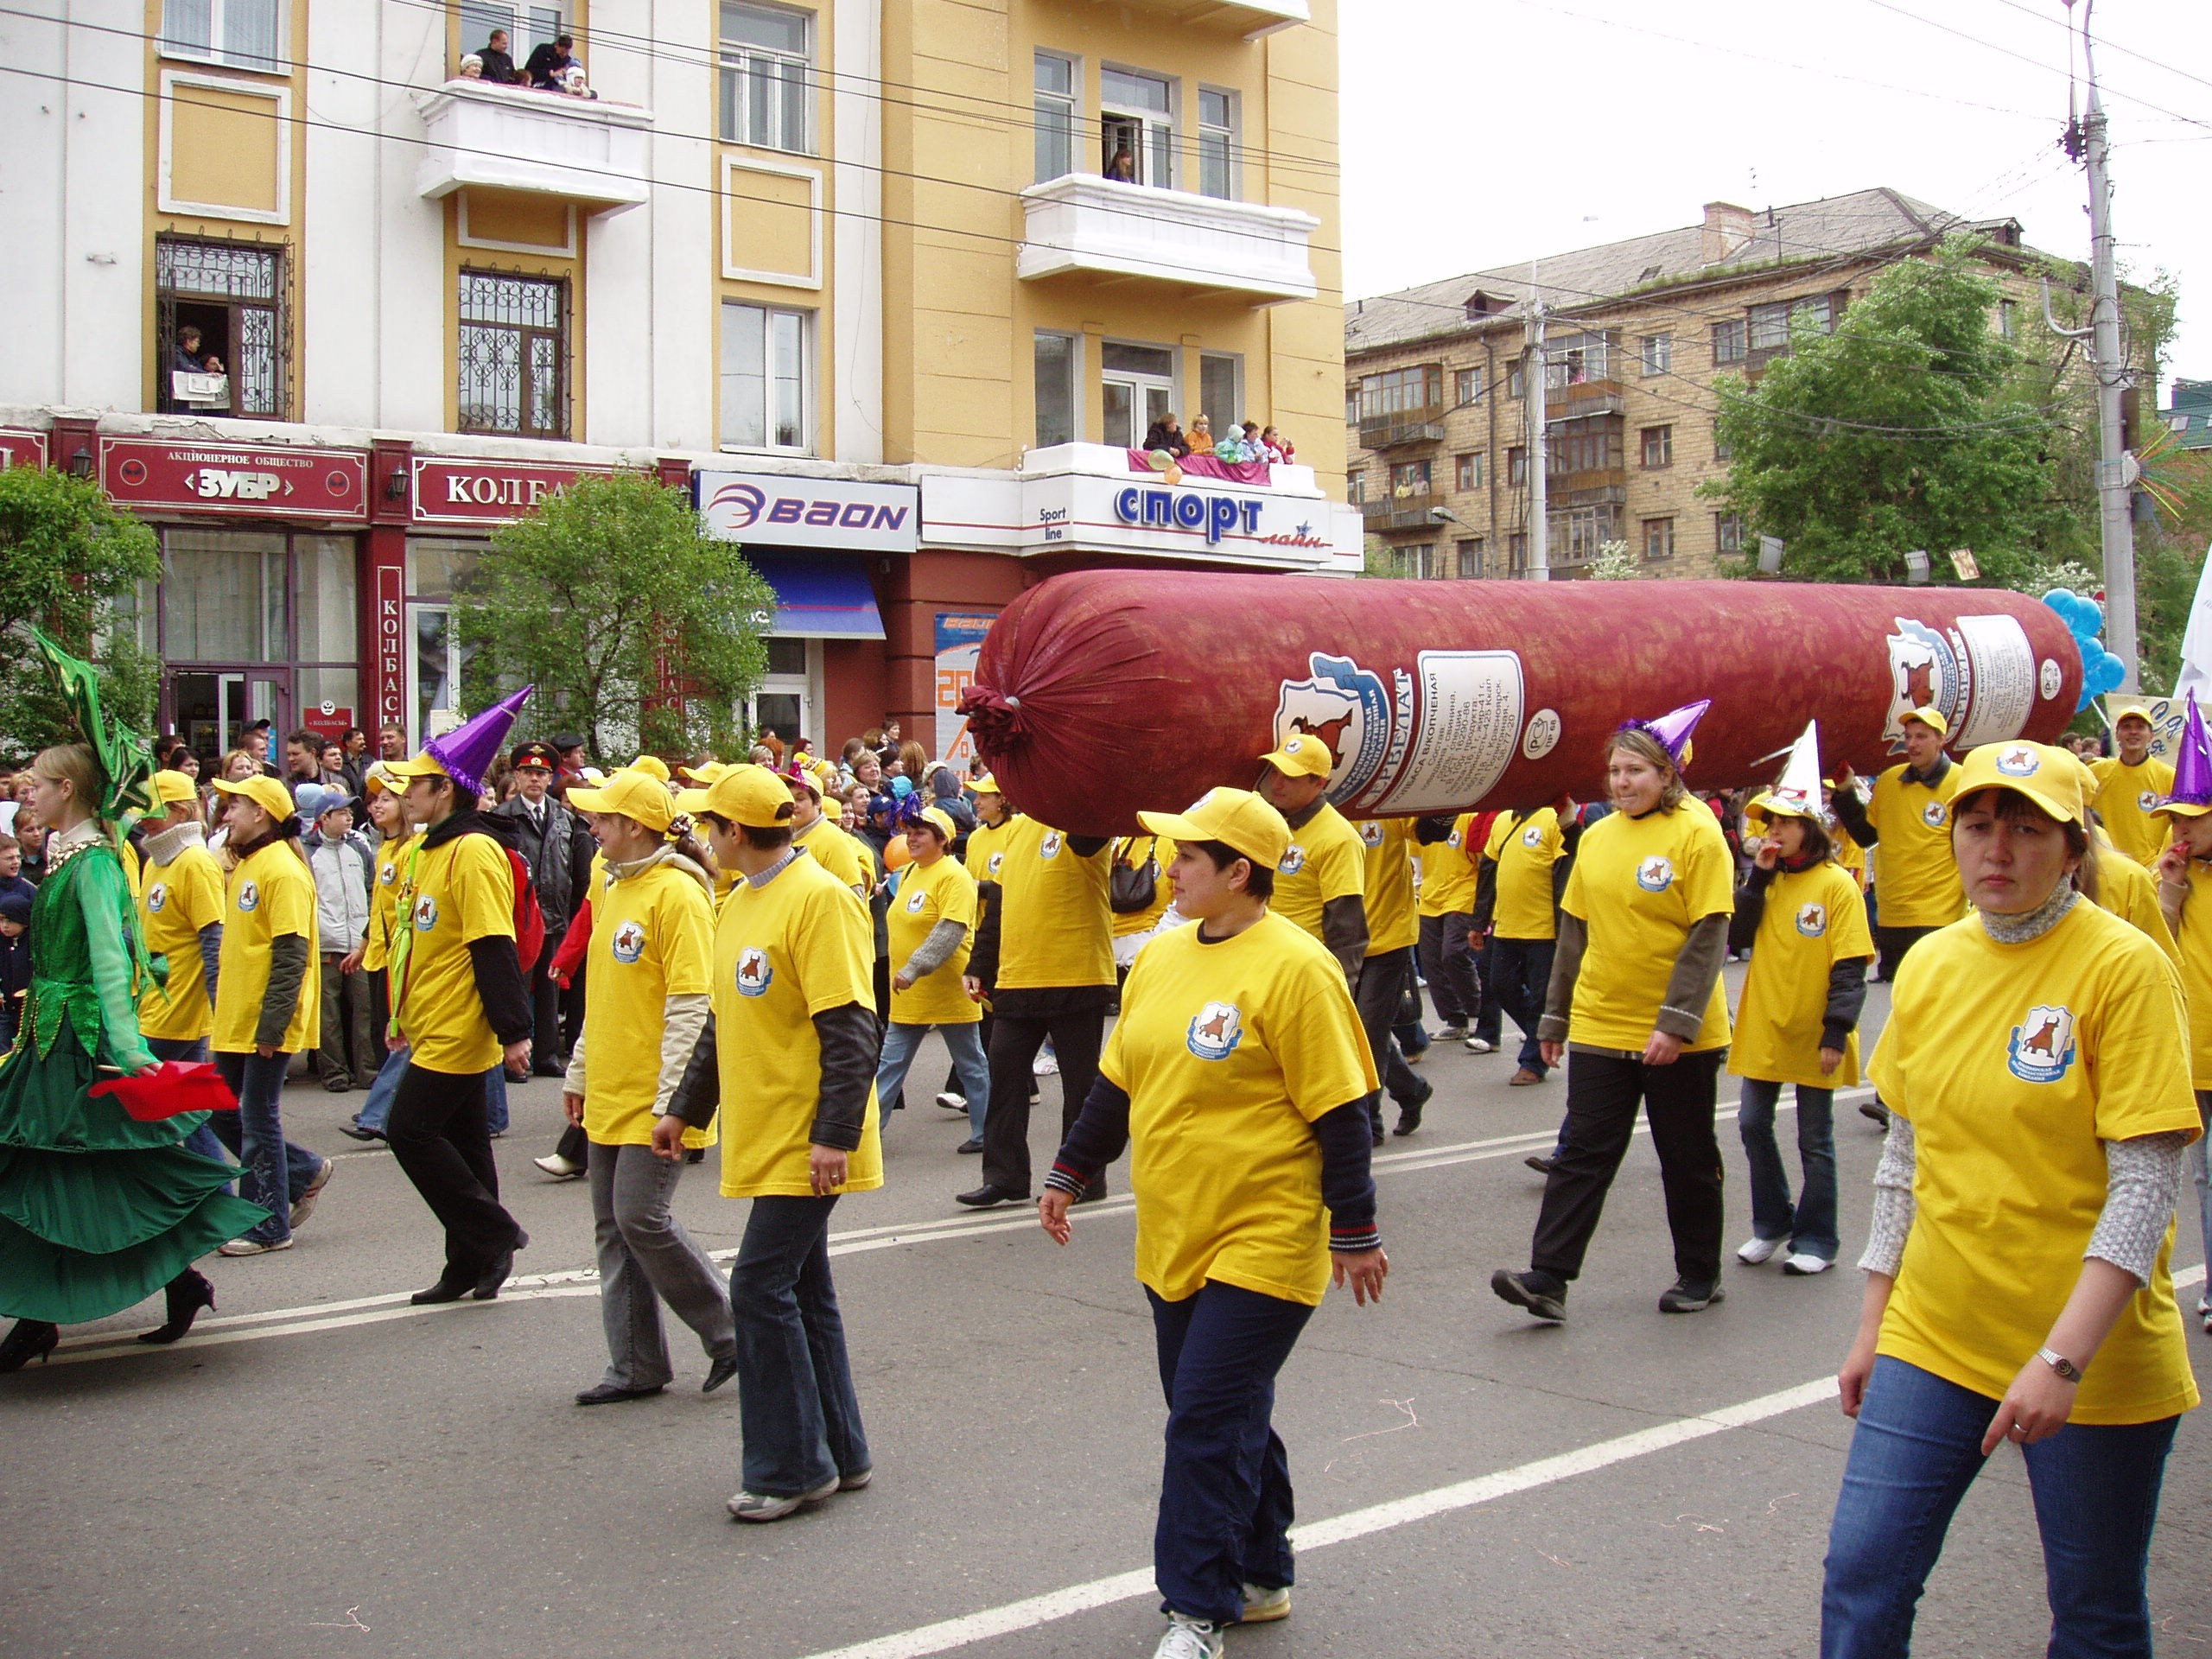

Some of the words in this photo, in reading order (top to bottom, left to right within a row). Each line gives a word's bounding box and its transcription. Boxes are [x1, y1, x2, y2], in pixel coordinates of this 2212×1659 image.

[167, 450, 250, 465] АКЦИОНЕРНОЕ
[255, 456, 314, 468] ОБЩЕСТВО
[1039, 506, 1066, 524] Sport
[1045, 526, 1063, 540] line
[938, 670, 974, 708] 20
[1421, 672, 1439, 755] В/КОПЧЕНАЯ
[1359, 718, 1387, 780] КОМПАНИЯ
